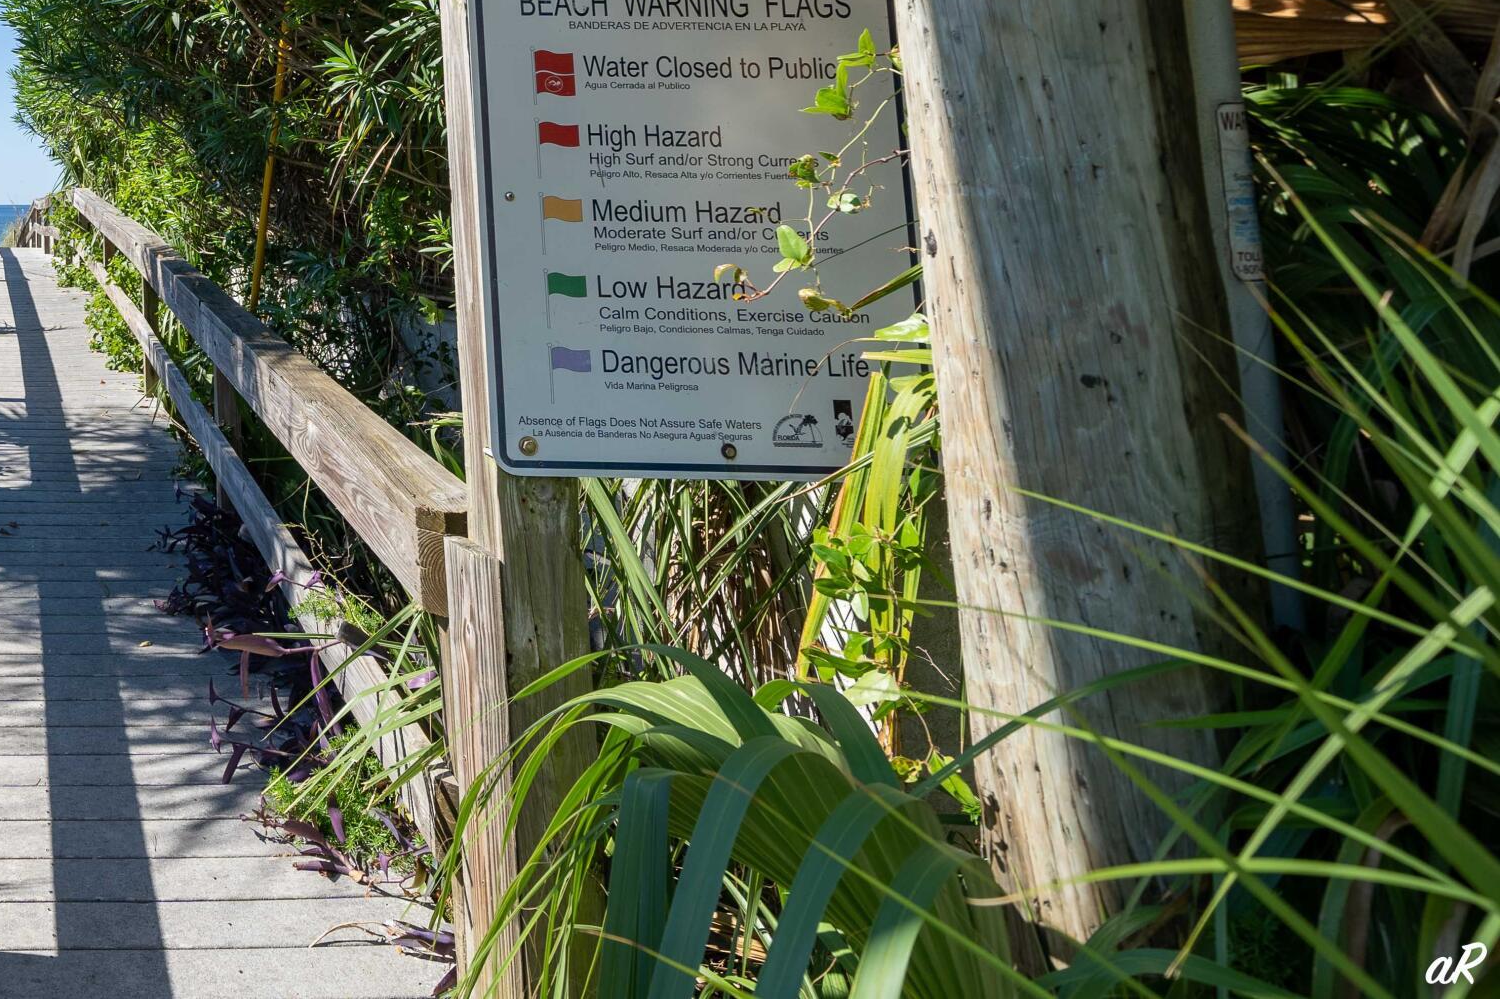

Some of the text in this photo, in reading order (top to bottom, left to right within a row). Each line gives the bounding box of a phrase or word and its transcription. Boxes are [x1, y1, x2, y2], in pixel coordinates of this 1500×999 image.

[568, 20, 806, 31] BANDERAS DE ADVERTENCIA EN LA PLAYA
[582, 55, 836, 79] Water Closed to Public
[584, 81, 690, 90] Agua Cerrada al Publico
[587, 123, 722, 152] High Hazard
[589, 152, 753, 169] High Surf and/or Strong
[589, 168, 620, 180] Peligro
[622, 170, 642, 178] Alto,
[644, 170, 678, 178] Resaca
[680, 170, 697, 178] Alta
[699, 171, 713, 180] y/o
[592, 198, 781, 224] Medium Hazard
[593, 225, 757, 241] Moderate Surf and/or
[594, 242, 625, 252] Peligro
[628, 243, 657, 252] Medio,
[660, 243, 694, 251] Resaca
[696, 244, 741, 252] Moderada
[744, 245, 758, 254] y/o
[597, 274, 647, 298] Low
[599, 306, 803, 323] Calm Conditions, Exercise
[599, 323, 824, 336] Peligro Bajo, Condiciones Calmas, Tenga Cuidado
[602, 349, 869, 380] Dangerous Marine Life
[604, 381, 698, 392] Vida Marina Peligrosa
[518, 415, 562, 428] Absence
[565, 416, 575, 426] of
[578, 416, 606, 430] Flags
[609, 417, 636, 427] Does
[639, 417, 657, 431] Not
[659, 418, 695, 432] Assure
[698, 418, 722, 432] Safe
[724, 419, 761, 429] Waters
[532, 428, 753, 442] La Ausencia de Banderas No Asegura Aguas Seguras
